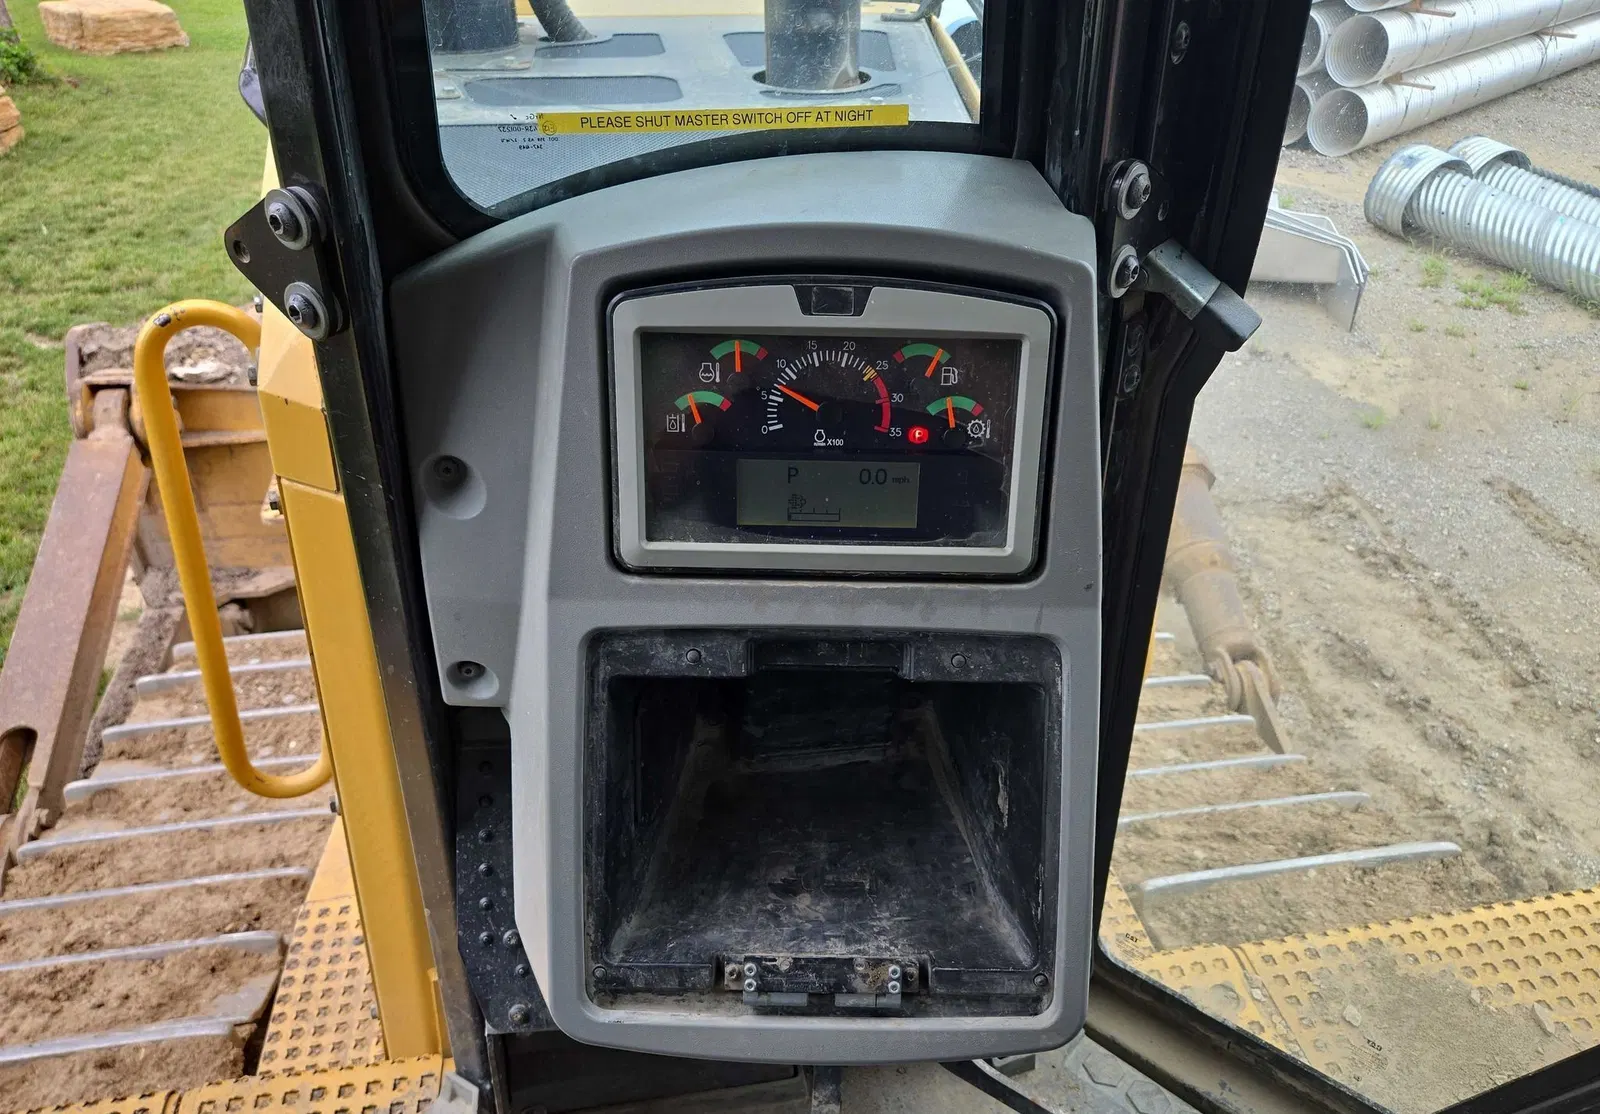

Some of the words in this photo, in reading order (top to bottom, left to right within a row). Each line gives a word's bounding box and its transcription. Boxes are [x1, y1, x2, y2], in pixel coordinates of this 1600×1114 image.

[580, 116, 631, 129] PLEASE
[635, 115, 671, 128] SHUT
[675, 113, 729, 127] MASTER
[732, 111, 783, 126] SWITCH
[786, 111, 812, 124] OFF
[815, 110, 831, 123] AT
[834, 109, 874, 122] NIGHT
[808, 340, 818, 350] 15
[843, 341, 856, 351] 20
[776, 359, 787, 369] 10
[876, 360, 889, 370] 25
[761, 391, 768, 400] 5
[891, 393, 904, 403] 30
[761, 425, 768, 435] 0
[889, 427, 902, 437] 35
[787, 467, 799, 484] P
[859, 468, 888, 485] 0.0
